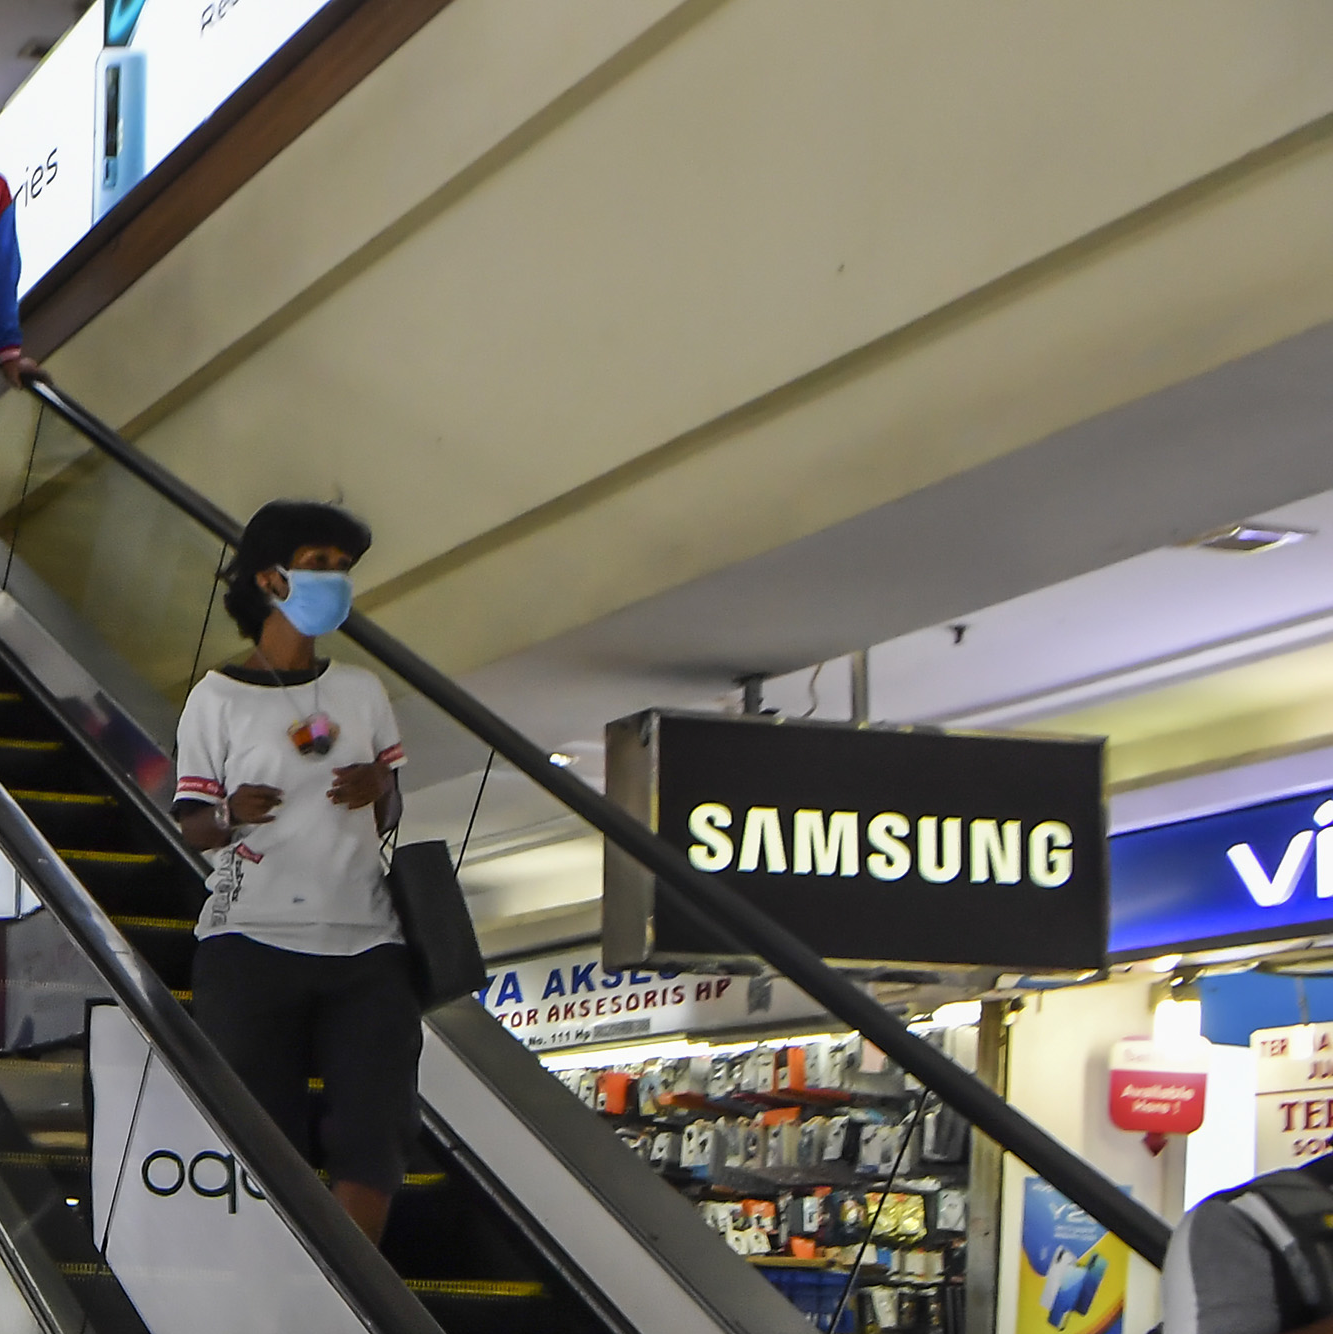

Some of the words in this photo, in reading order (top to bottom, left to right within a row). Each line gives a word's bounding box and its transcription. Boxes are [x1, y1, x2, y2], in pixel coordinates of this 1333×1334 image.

[686, 802, 1074, 889] SAMSUNG
[546, 985, 686, 1024] AKSESORIS
[695, 978, 733, 1002] HP
[550, 1030, 571, 1044] 111
[573, 1028, 592, 1042] Hp
[1119, 1082, 1196, 1103] Available
[1131, 1101, 1169, 1117] Here
